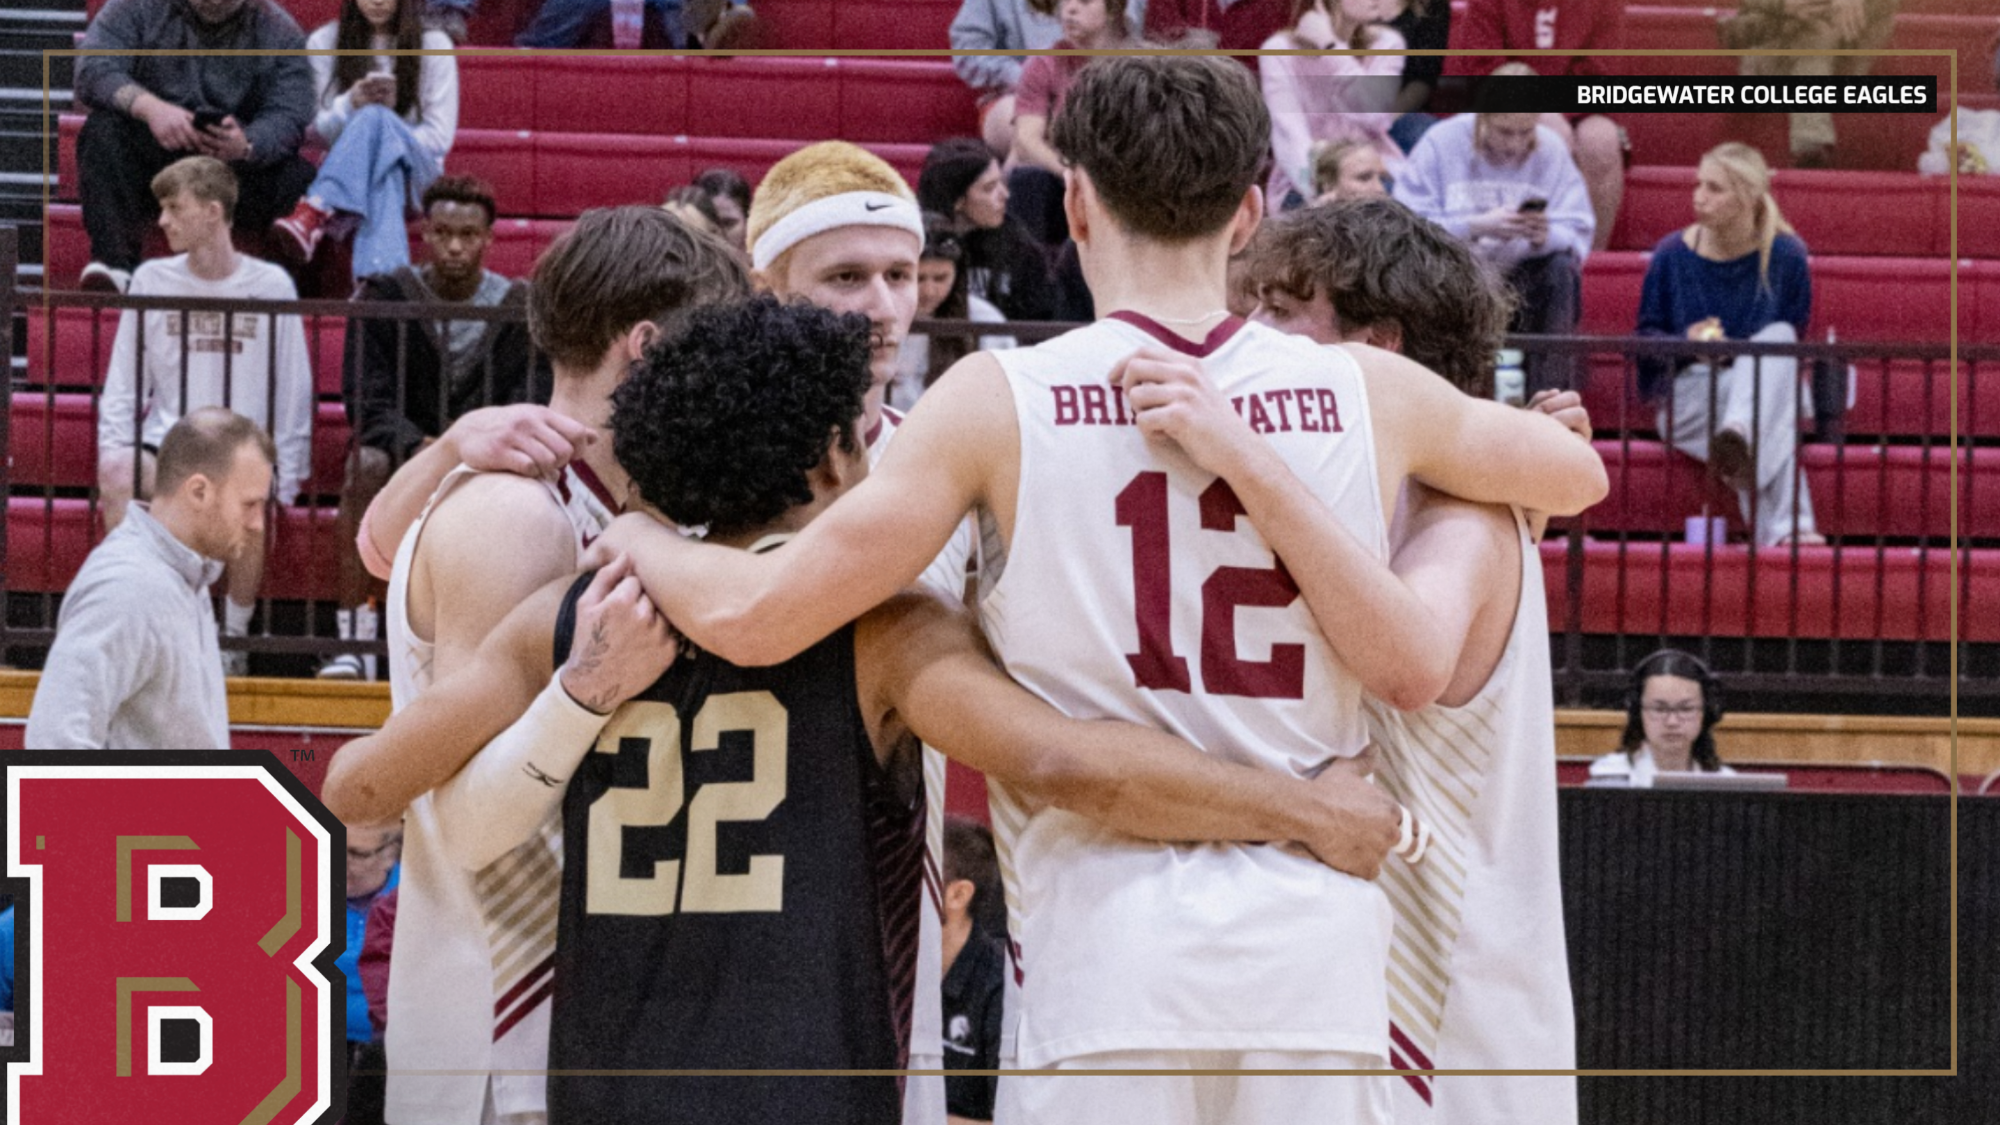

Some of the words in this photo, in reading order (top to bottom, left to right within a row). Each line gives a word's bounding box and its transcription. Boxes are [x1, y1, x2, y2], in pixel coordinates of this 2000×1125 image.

[1050, 384, 1344, 434] BRIATER
[1115, 470, 1305, 700] 12
[586, 690, 788, 916] 22
